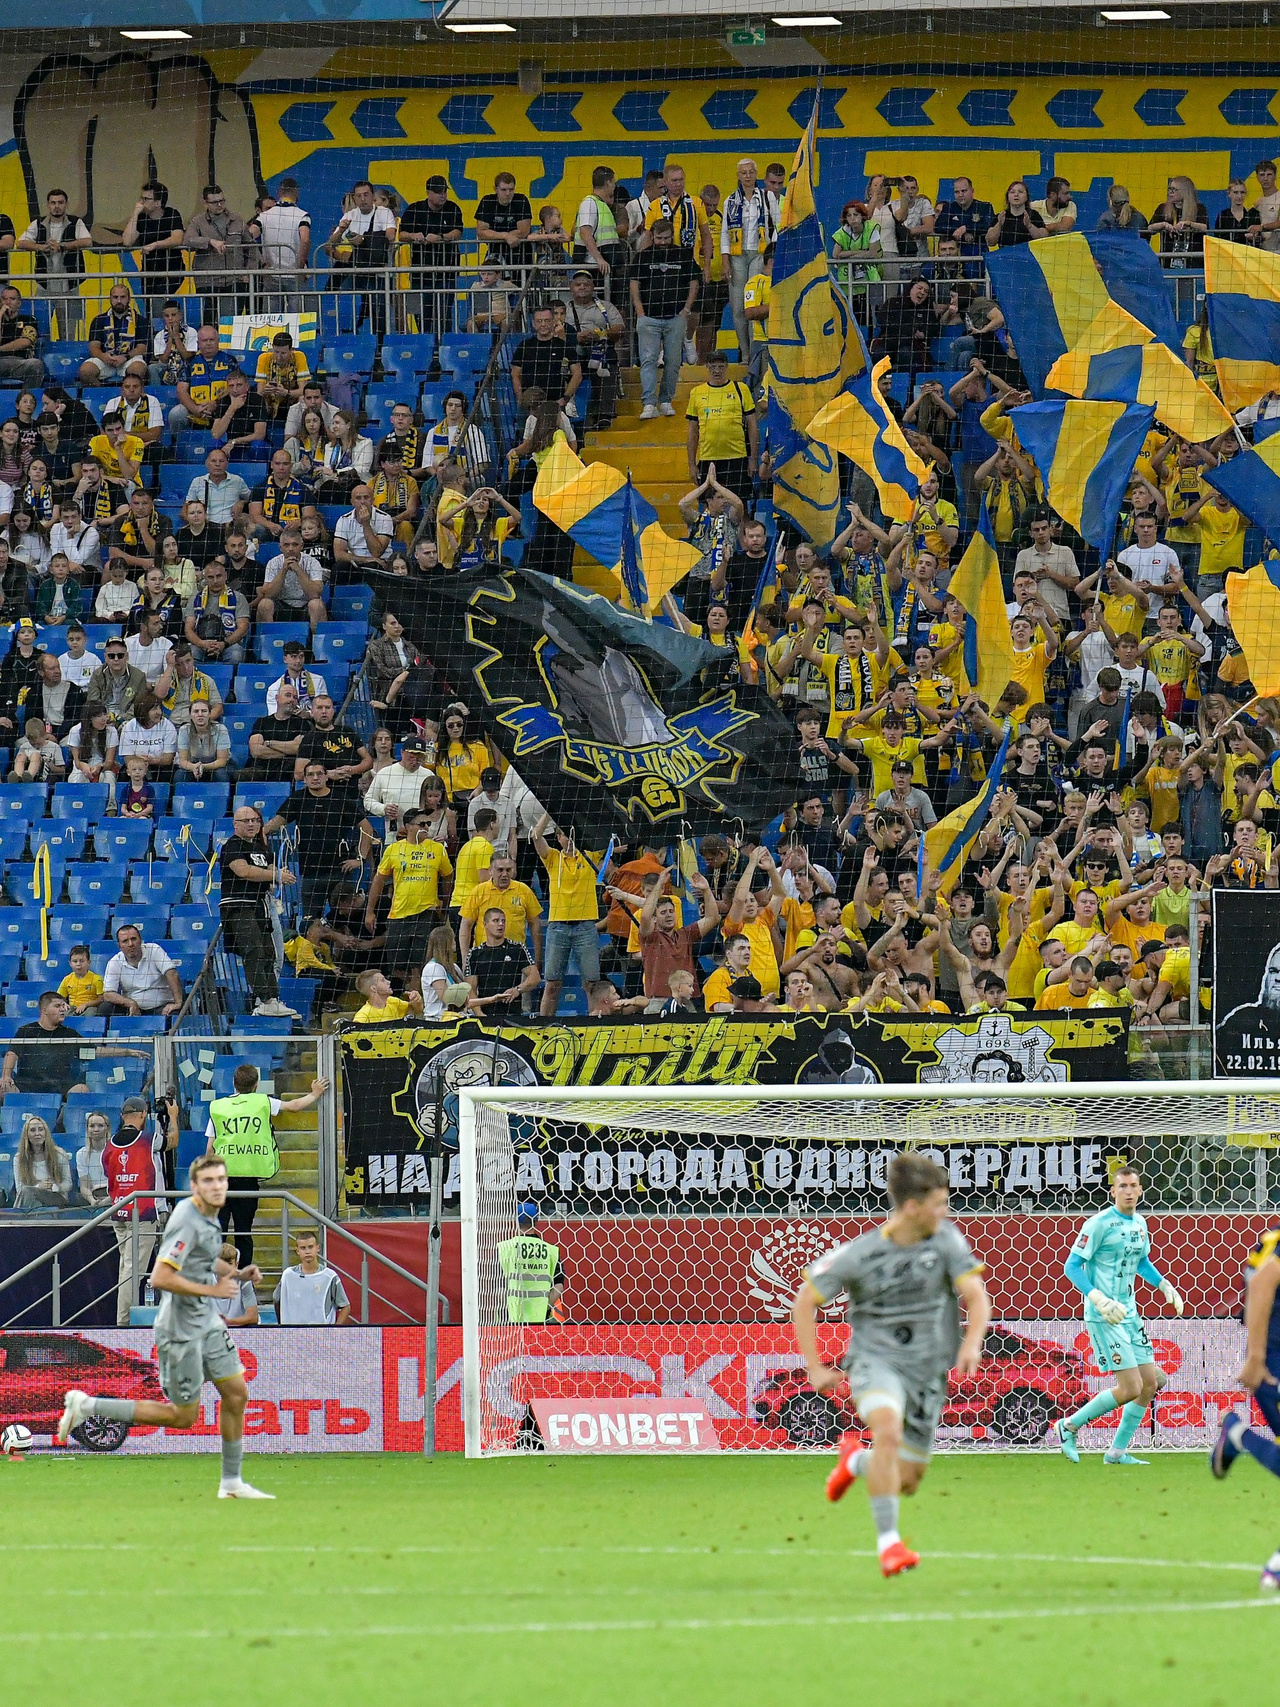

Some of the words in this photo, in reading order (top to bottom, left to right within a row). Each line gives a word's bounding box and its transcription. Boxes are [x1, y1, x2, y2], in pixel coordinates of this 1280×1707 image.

[976, 1037, 1011, 1049] 1698
[222, 1116, 262, 1136] K179
[368, 1154, 430, 1194] НА
[558, 1148, 749, 1195] ГОРОДА
[117, 1209, 128, 1217] 072
[514, 1242, 548, 1260] 18235
[547, 1412, 704, 1447] FONBET
